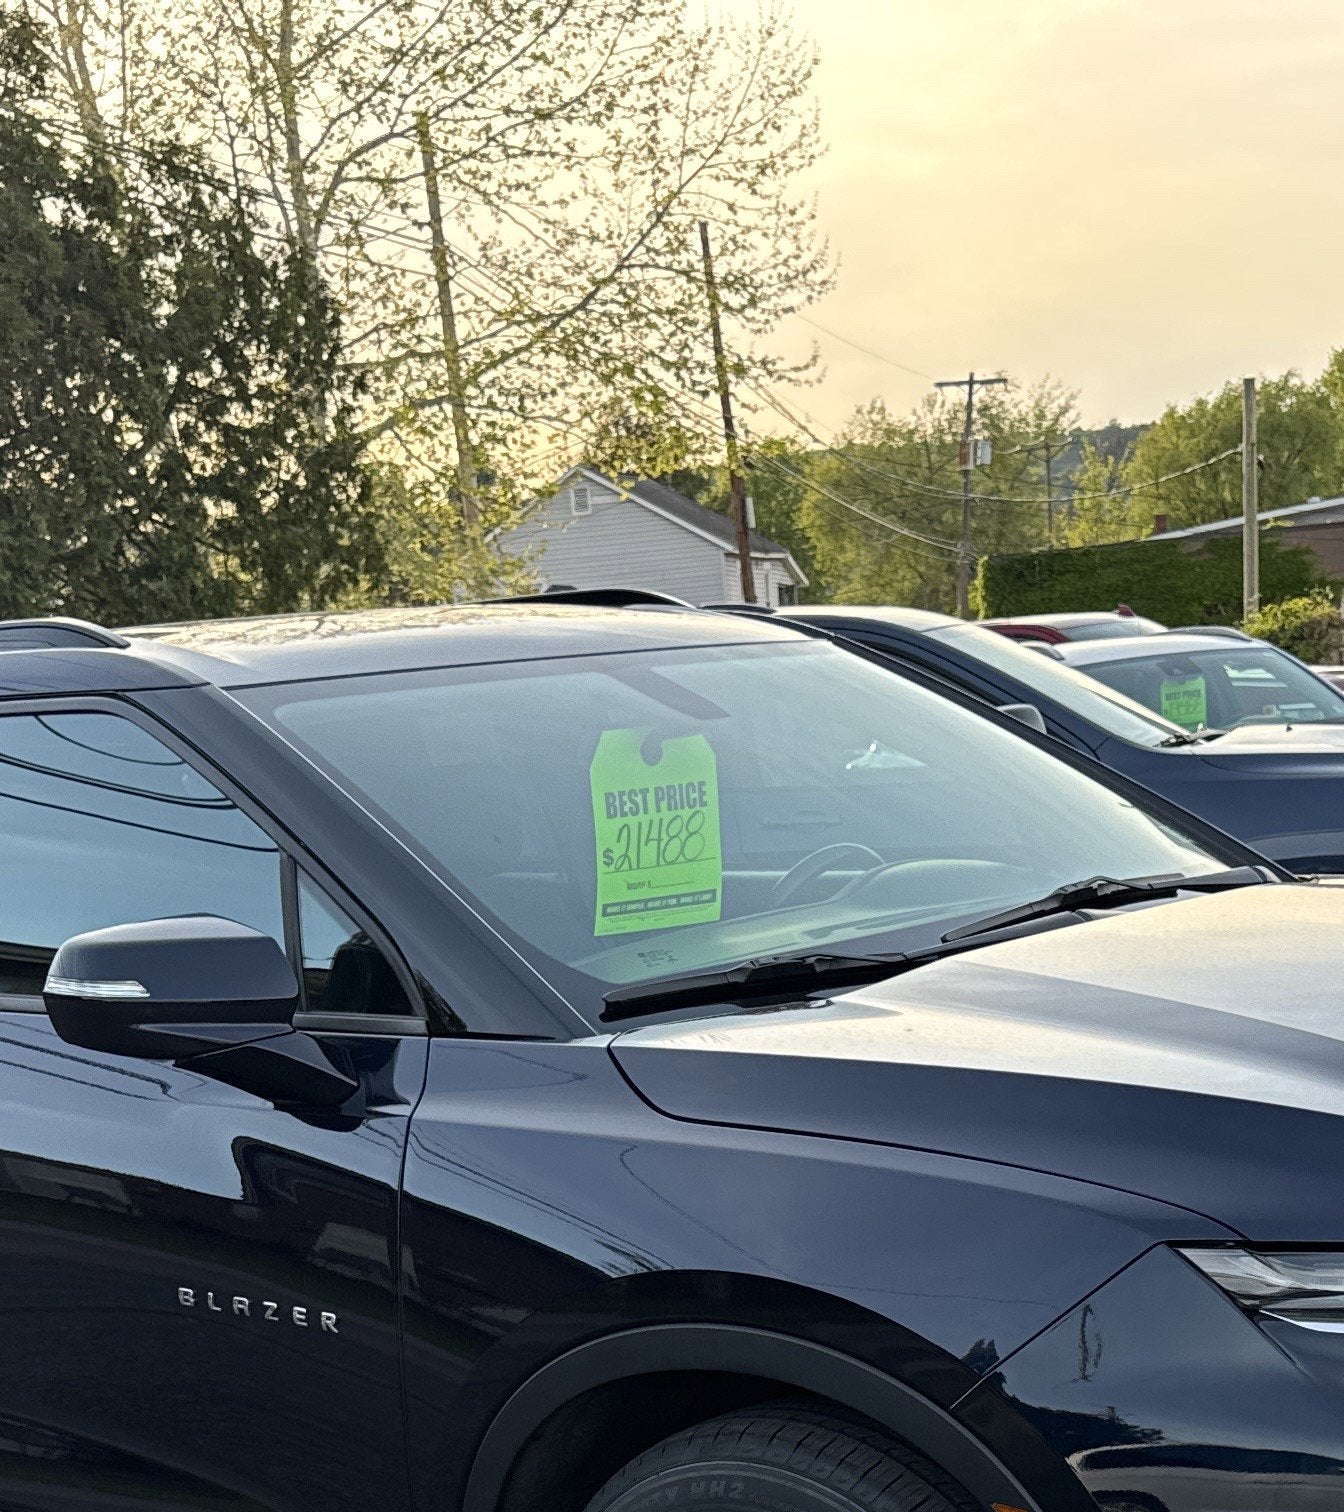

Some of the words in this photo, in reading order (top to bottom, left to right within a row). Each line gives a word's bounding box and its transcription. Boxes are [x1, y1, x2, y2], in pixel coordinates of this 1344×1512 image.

[605, 788, 650, 819] BEST
[654, 781, 707, 813] PRICE
[178, 1287, 339, 1333] BLAZER
